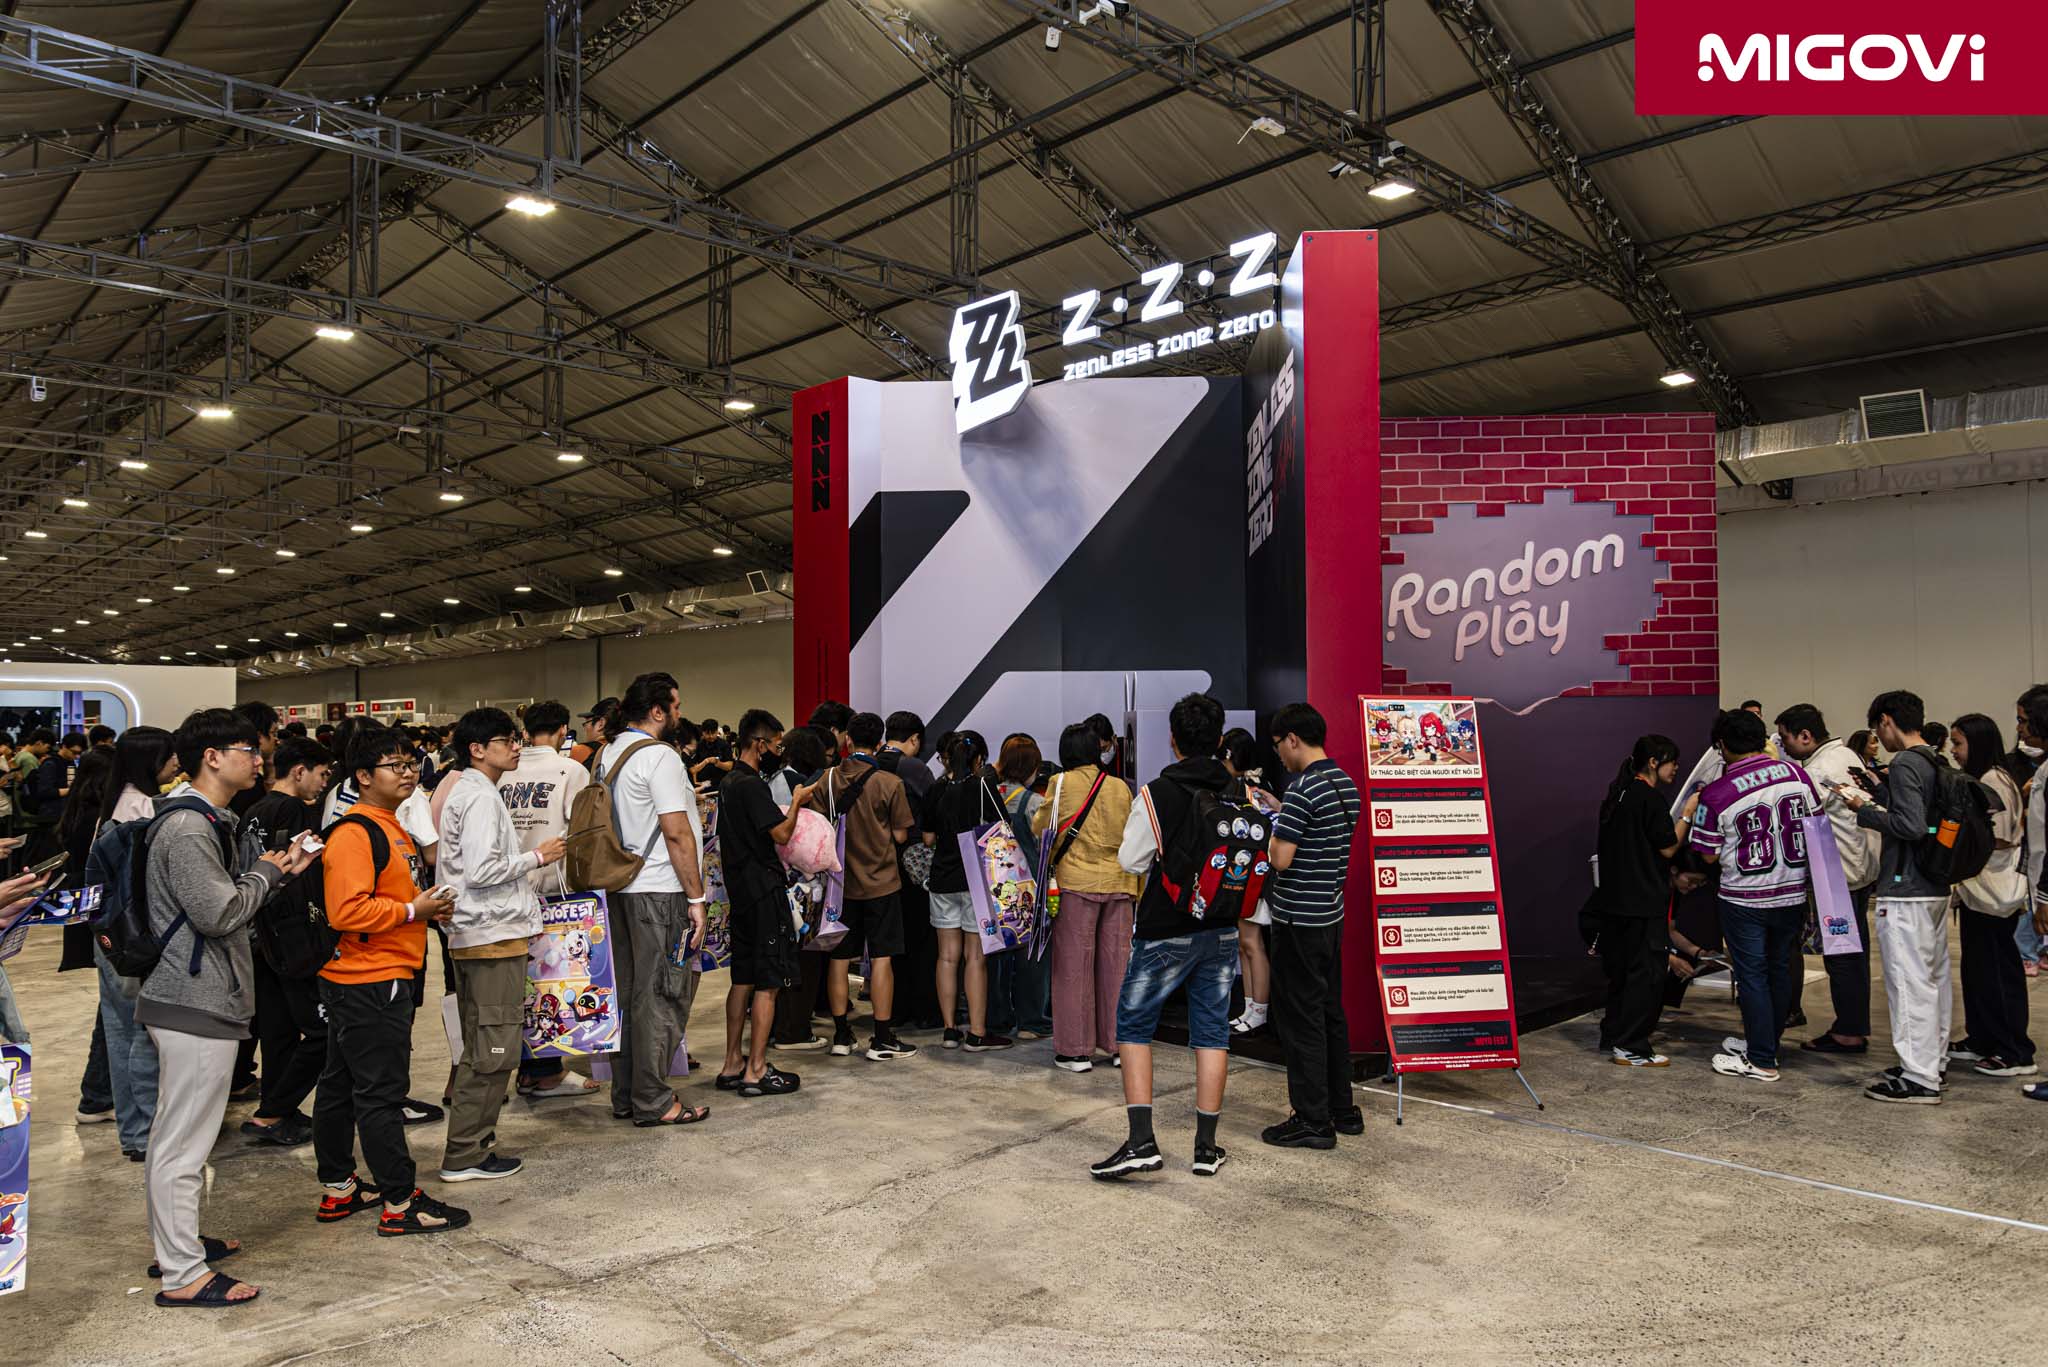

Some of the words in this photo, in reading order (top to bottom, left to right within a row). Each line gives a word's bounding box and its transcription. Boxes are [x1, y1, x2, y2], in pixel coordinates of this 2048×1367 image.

[1386, 534, 1625, 642] Random
[1731, 763, 1792, 794] DXPRO
[541, 901, 595, 921] OYOFEST
